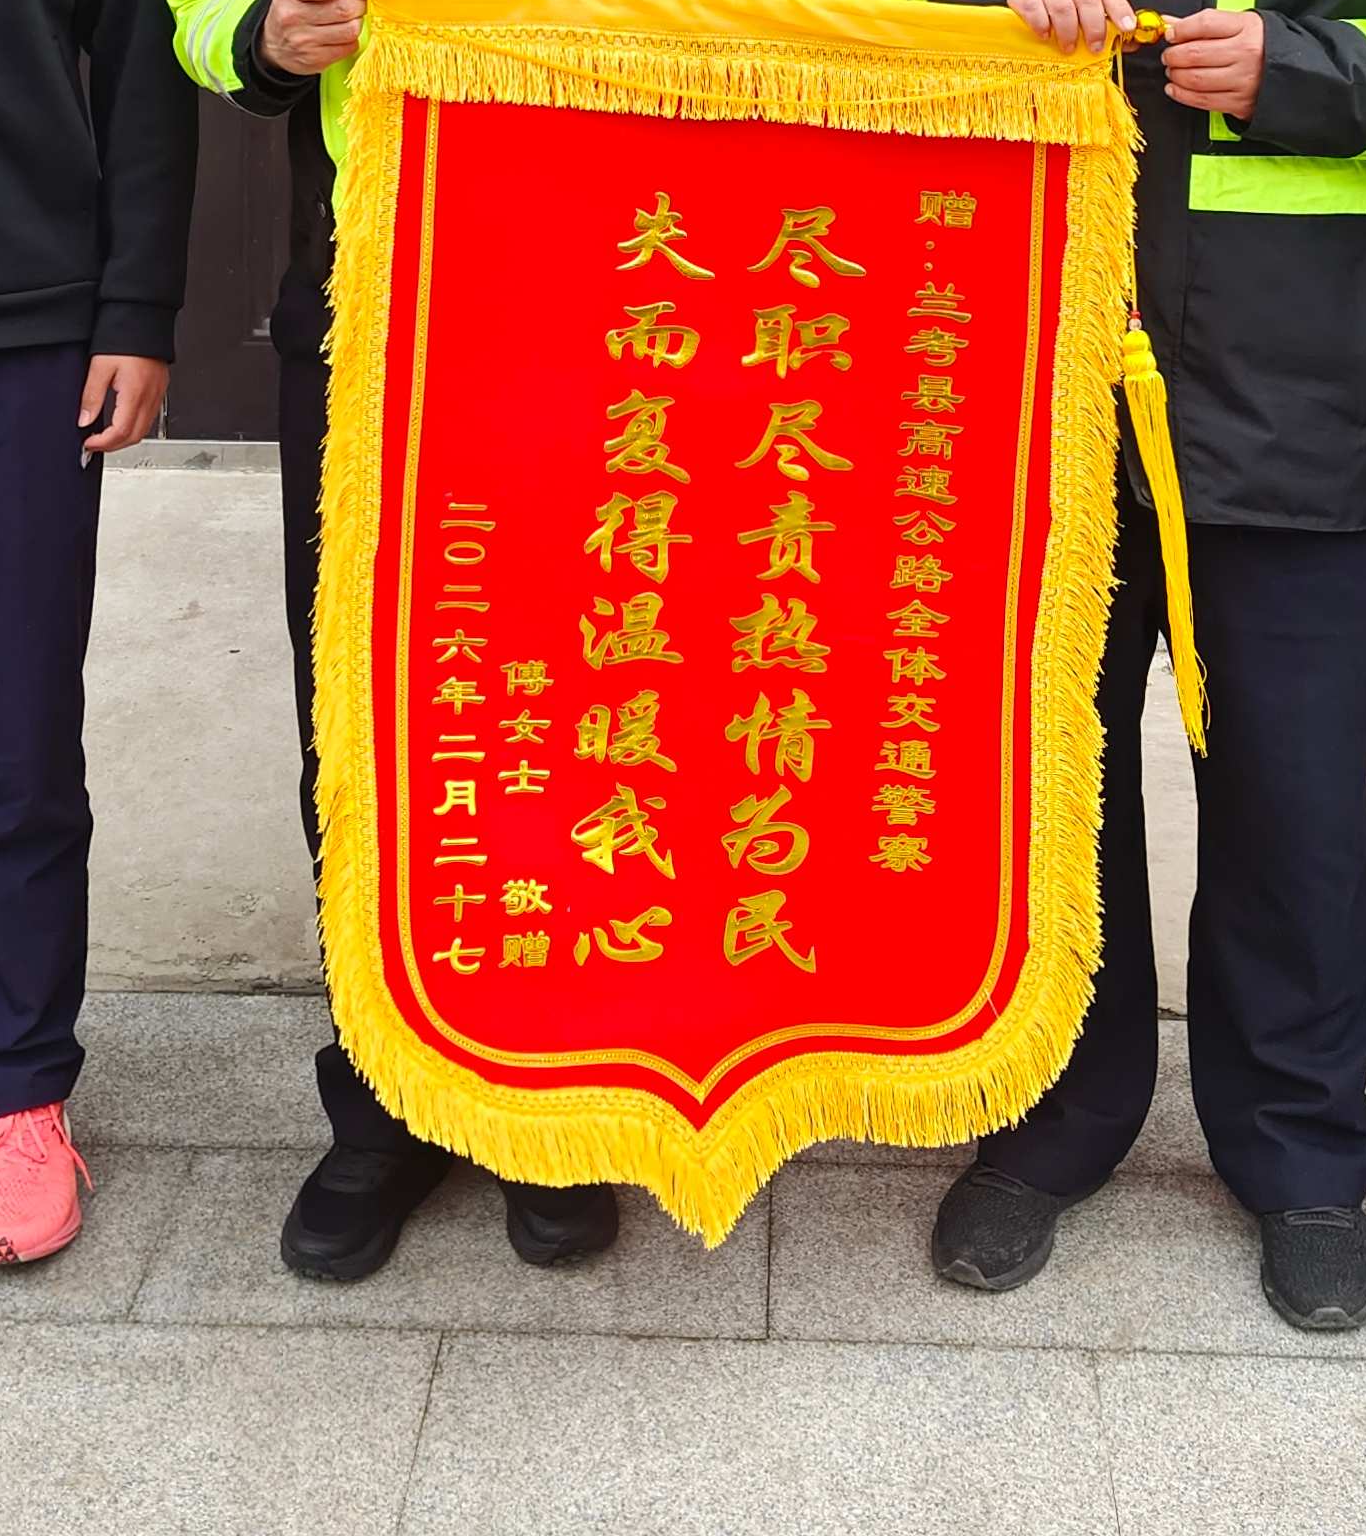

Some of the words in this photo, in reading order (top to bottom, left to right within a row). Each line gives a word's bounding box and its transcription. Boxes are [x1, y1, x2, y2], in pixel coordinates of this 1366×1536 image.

[498, 879, 554, 969] 敬赠
[571, 191, 716, 967] 失而复得温暖我心
[721, 206, 867, 973] 尽职尽责热情为民
